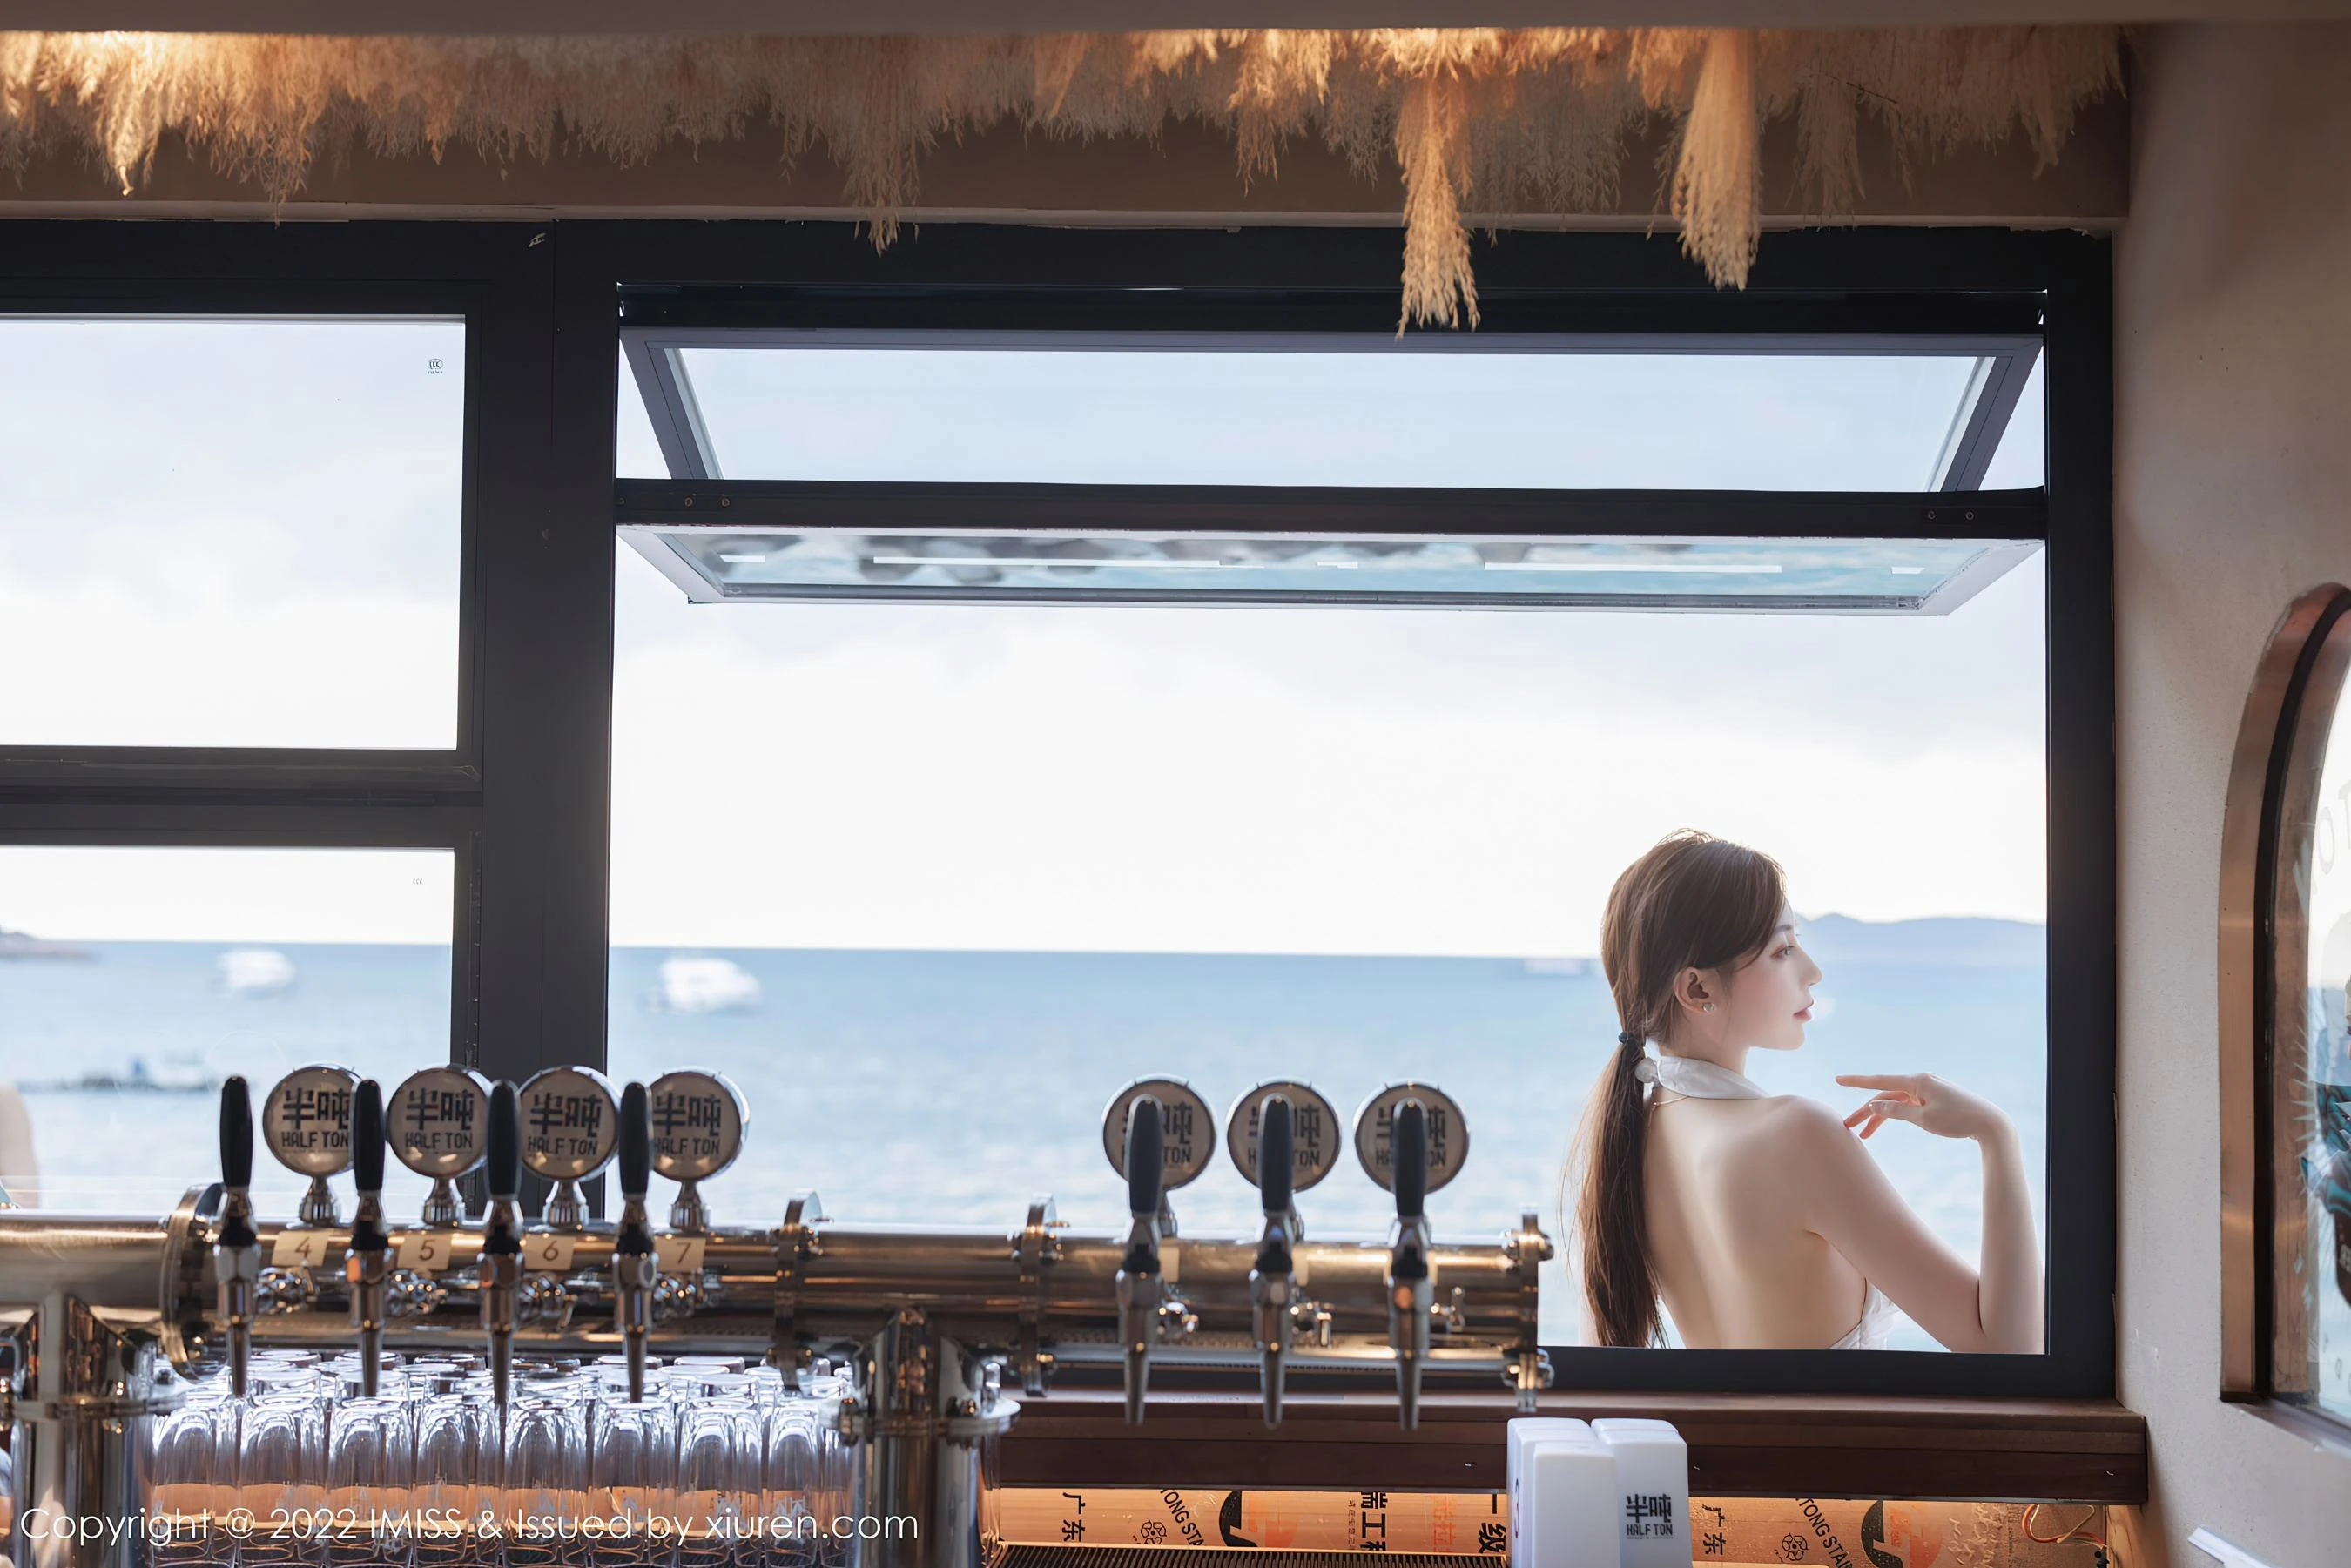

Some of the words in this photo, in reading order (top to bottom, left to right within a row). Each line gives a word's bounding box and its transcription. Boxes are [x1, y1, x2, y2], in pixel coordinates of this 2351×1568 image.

[281, 1132, 318, 1147] HALF
[322, 1132, 349, 1147] TON
[405, 1132, 441, 1148] HALF
[444, 1132, 473, 1148] TON
[528, 1135, 565, 1154] HALF
[569, 1138, 598, 1156] TON
[654, 1137, 689, 1154] HALF
[693, 1137, 720, 1155] TON
[1163, 1145, 1192, 1163] TON
[294, 1236, 312, 1259] 4
[418, 1239, 436, 1261] 5
[542, 1240, 559, 1262] 6
[676, 1242, 691, 1264] 7
[1061, 1491, 1086, 1542] 广东
[1626, 1493, 1673, 1524] 半吨
[1627, 1524, 1651, 1536] HALF
[1654, 1524, 1673, 1536] TON
[1701, 1504, 1727, 1556] 广东
